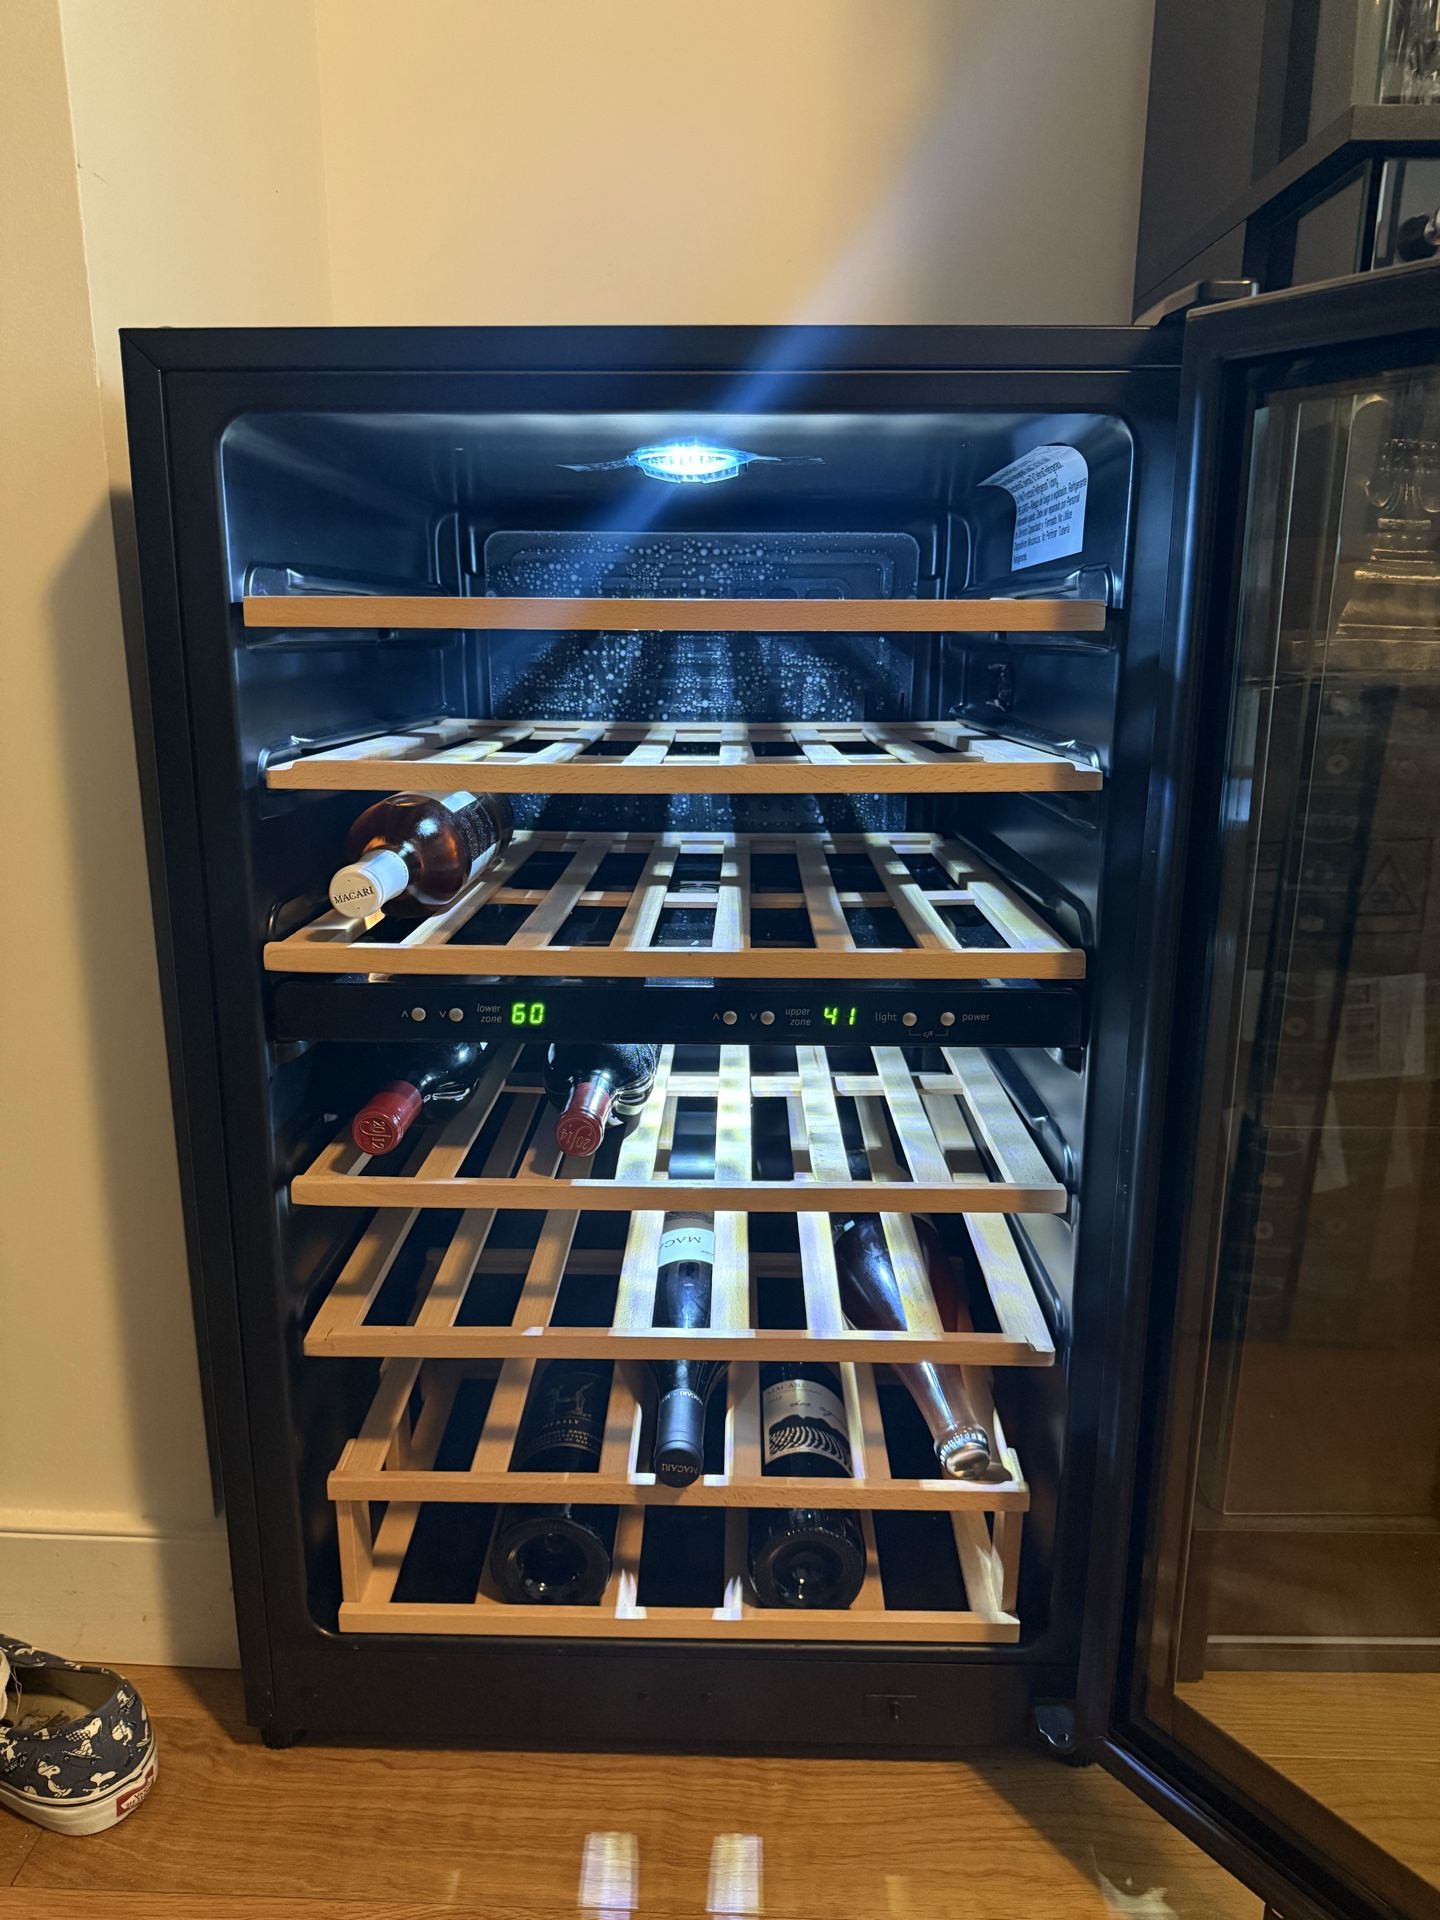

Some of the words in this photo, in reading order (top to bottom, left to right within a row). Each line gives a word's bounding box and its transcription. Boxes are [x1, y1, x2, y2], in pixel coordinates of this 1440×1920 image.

[333, 886, 374, 904] MACARI
[477, 1003, 501, 1013] lower
[785, 1007, 811, 1017] upper
[511, 1002, 545, 1025] 60
[823, 1007, 857, 1026] 41
[875, 1012, 897, 1022] light
[962, 1012, 990, 1022] power
[480, 1015, 502, 1023] zone
[790, 1018, 812, 1026] zone
[661, 1463, 699, 1474] MACARI
